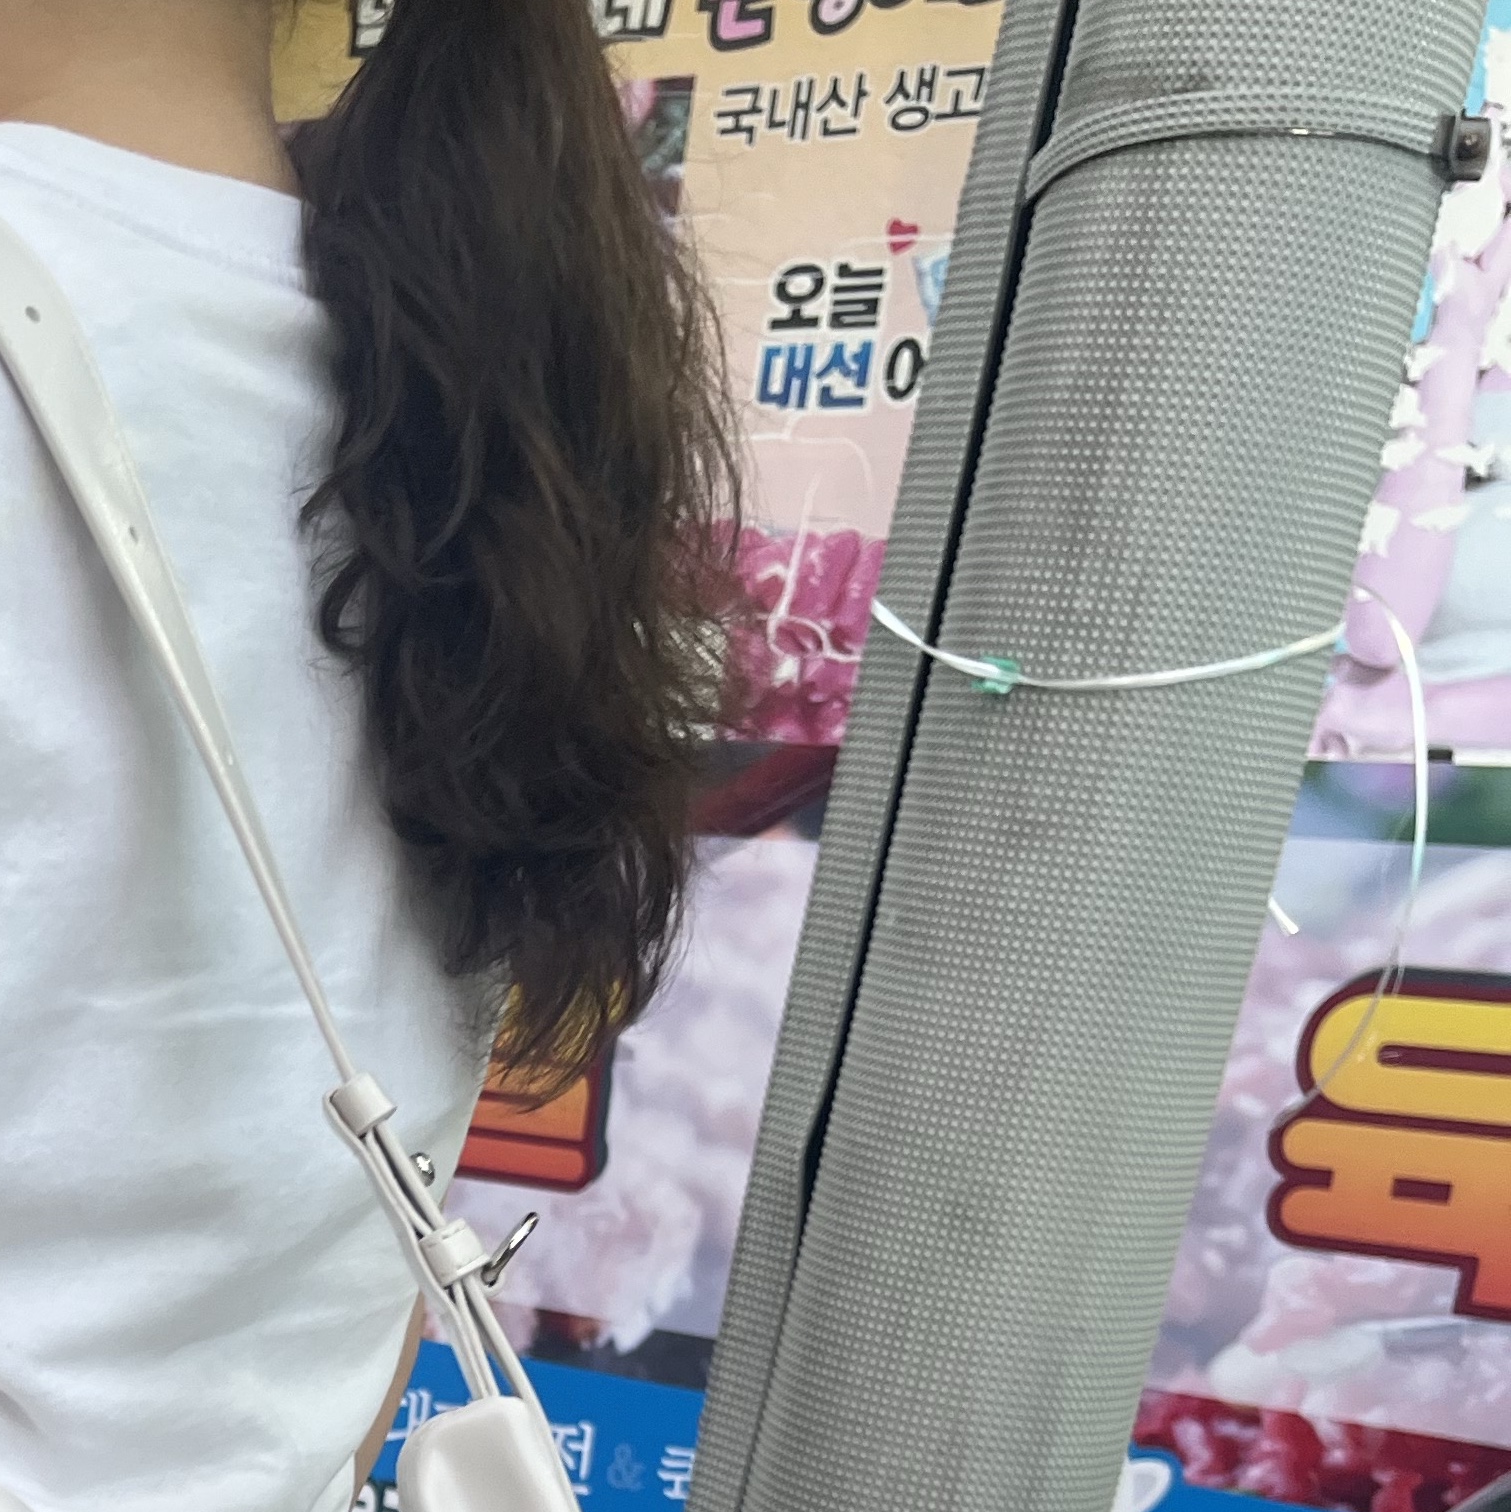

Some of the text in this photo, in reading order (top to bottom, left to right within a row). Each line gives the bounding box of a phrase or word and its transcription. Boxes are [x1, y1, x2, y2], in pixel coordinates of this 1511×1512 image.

[714, 72, 869, 147] 국내산
[768, 261, 885, 331] 오늘
[759, 339, 875, 410] 대선
